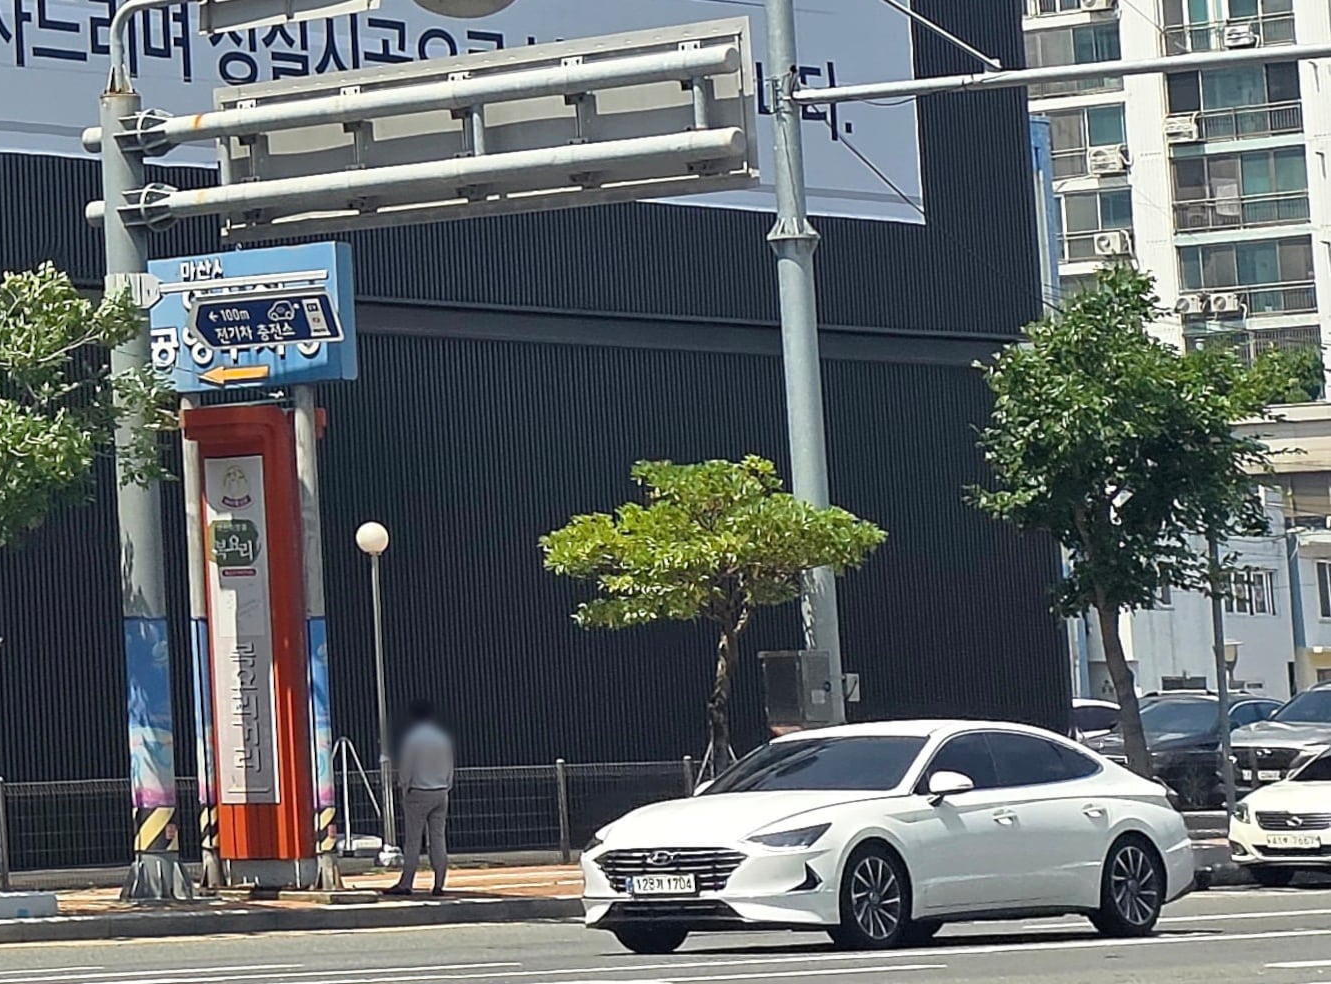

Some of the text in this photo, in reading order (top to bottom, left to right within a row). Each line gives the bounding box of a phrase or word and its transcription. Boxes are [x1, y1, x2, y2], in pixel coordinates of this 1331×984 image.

[221, 308, 250, 322] 100m
[214, 325, 252, 345] 전기차
[667, 877, 692, 890] 1704
